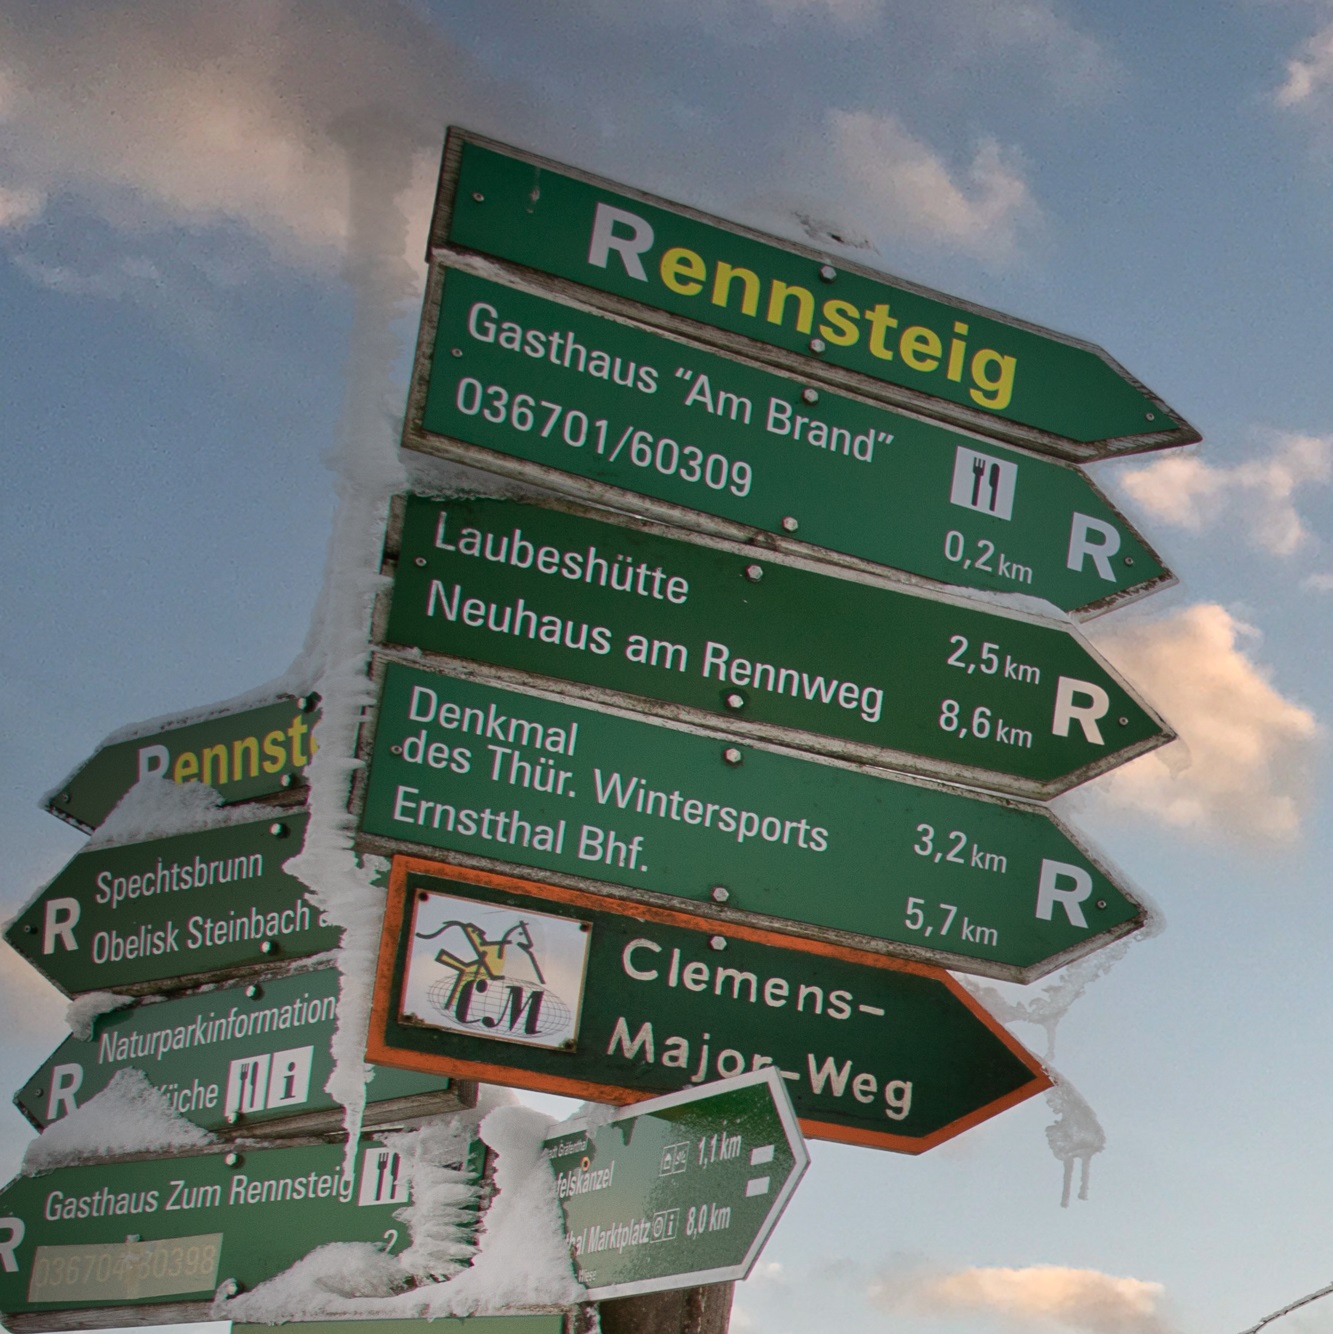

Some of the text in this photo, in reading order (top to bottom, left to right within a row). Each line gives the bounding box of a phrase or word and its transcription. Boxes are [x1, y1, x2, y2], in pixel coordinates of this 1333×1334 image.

[587, 202, 1018, 410] Rennsteig
[467, 301, 659, 394] Gasthaus
[455, 376, 755, 498] 036701/60309
[434, 511, 689, 604] Laubeshütte
[943, 529, 1034, 585] 0,2 km
[1066, 511, 1122, 583] R
[427, 579, 885, 723] Neuhaus am Rennweg
[946, 634, 1041, 685] 2,5 km
[408, 685, 578, 756] Denkmal
[938, 698, 1034, 749] 8,6 km
[1051, 676, 1110, 746] R
[137, 713, 320, 787] Rennst
[402, 729, 829, 854] des Thür. Wintersports
[392, 786, 649, 873] Ernstthal Bhf.
[912, 823, 1008, 873] 3,2 km
[95, 852, 264, 908] Spechtsbrunn
[1034, 858, 1093, 929] R
[42, 896, 81, 955] R
[91, 922, 180, 964] Obelisk
[187, 898, 311, 951] Steinbach
[904, 897, 999, 947] 5,7 km
[621, 937, 885, 1021] Clemens-
[99, 993, 336, 1064] Naturparkinformation
[46, 1062, 84, 1120] R
[698, 1131, 742, 1169] 1,1 km
[44, 1165, 354, 1221] Gasthaus Zum Rennsteig
[685, 1202, 732, 1240] 8,0 km
[587, 1218, 652, 1255] Marktplatz
